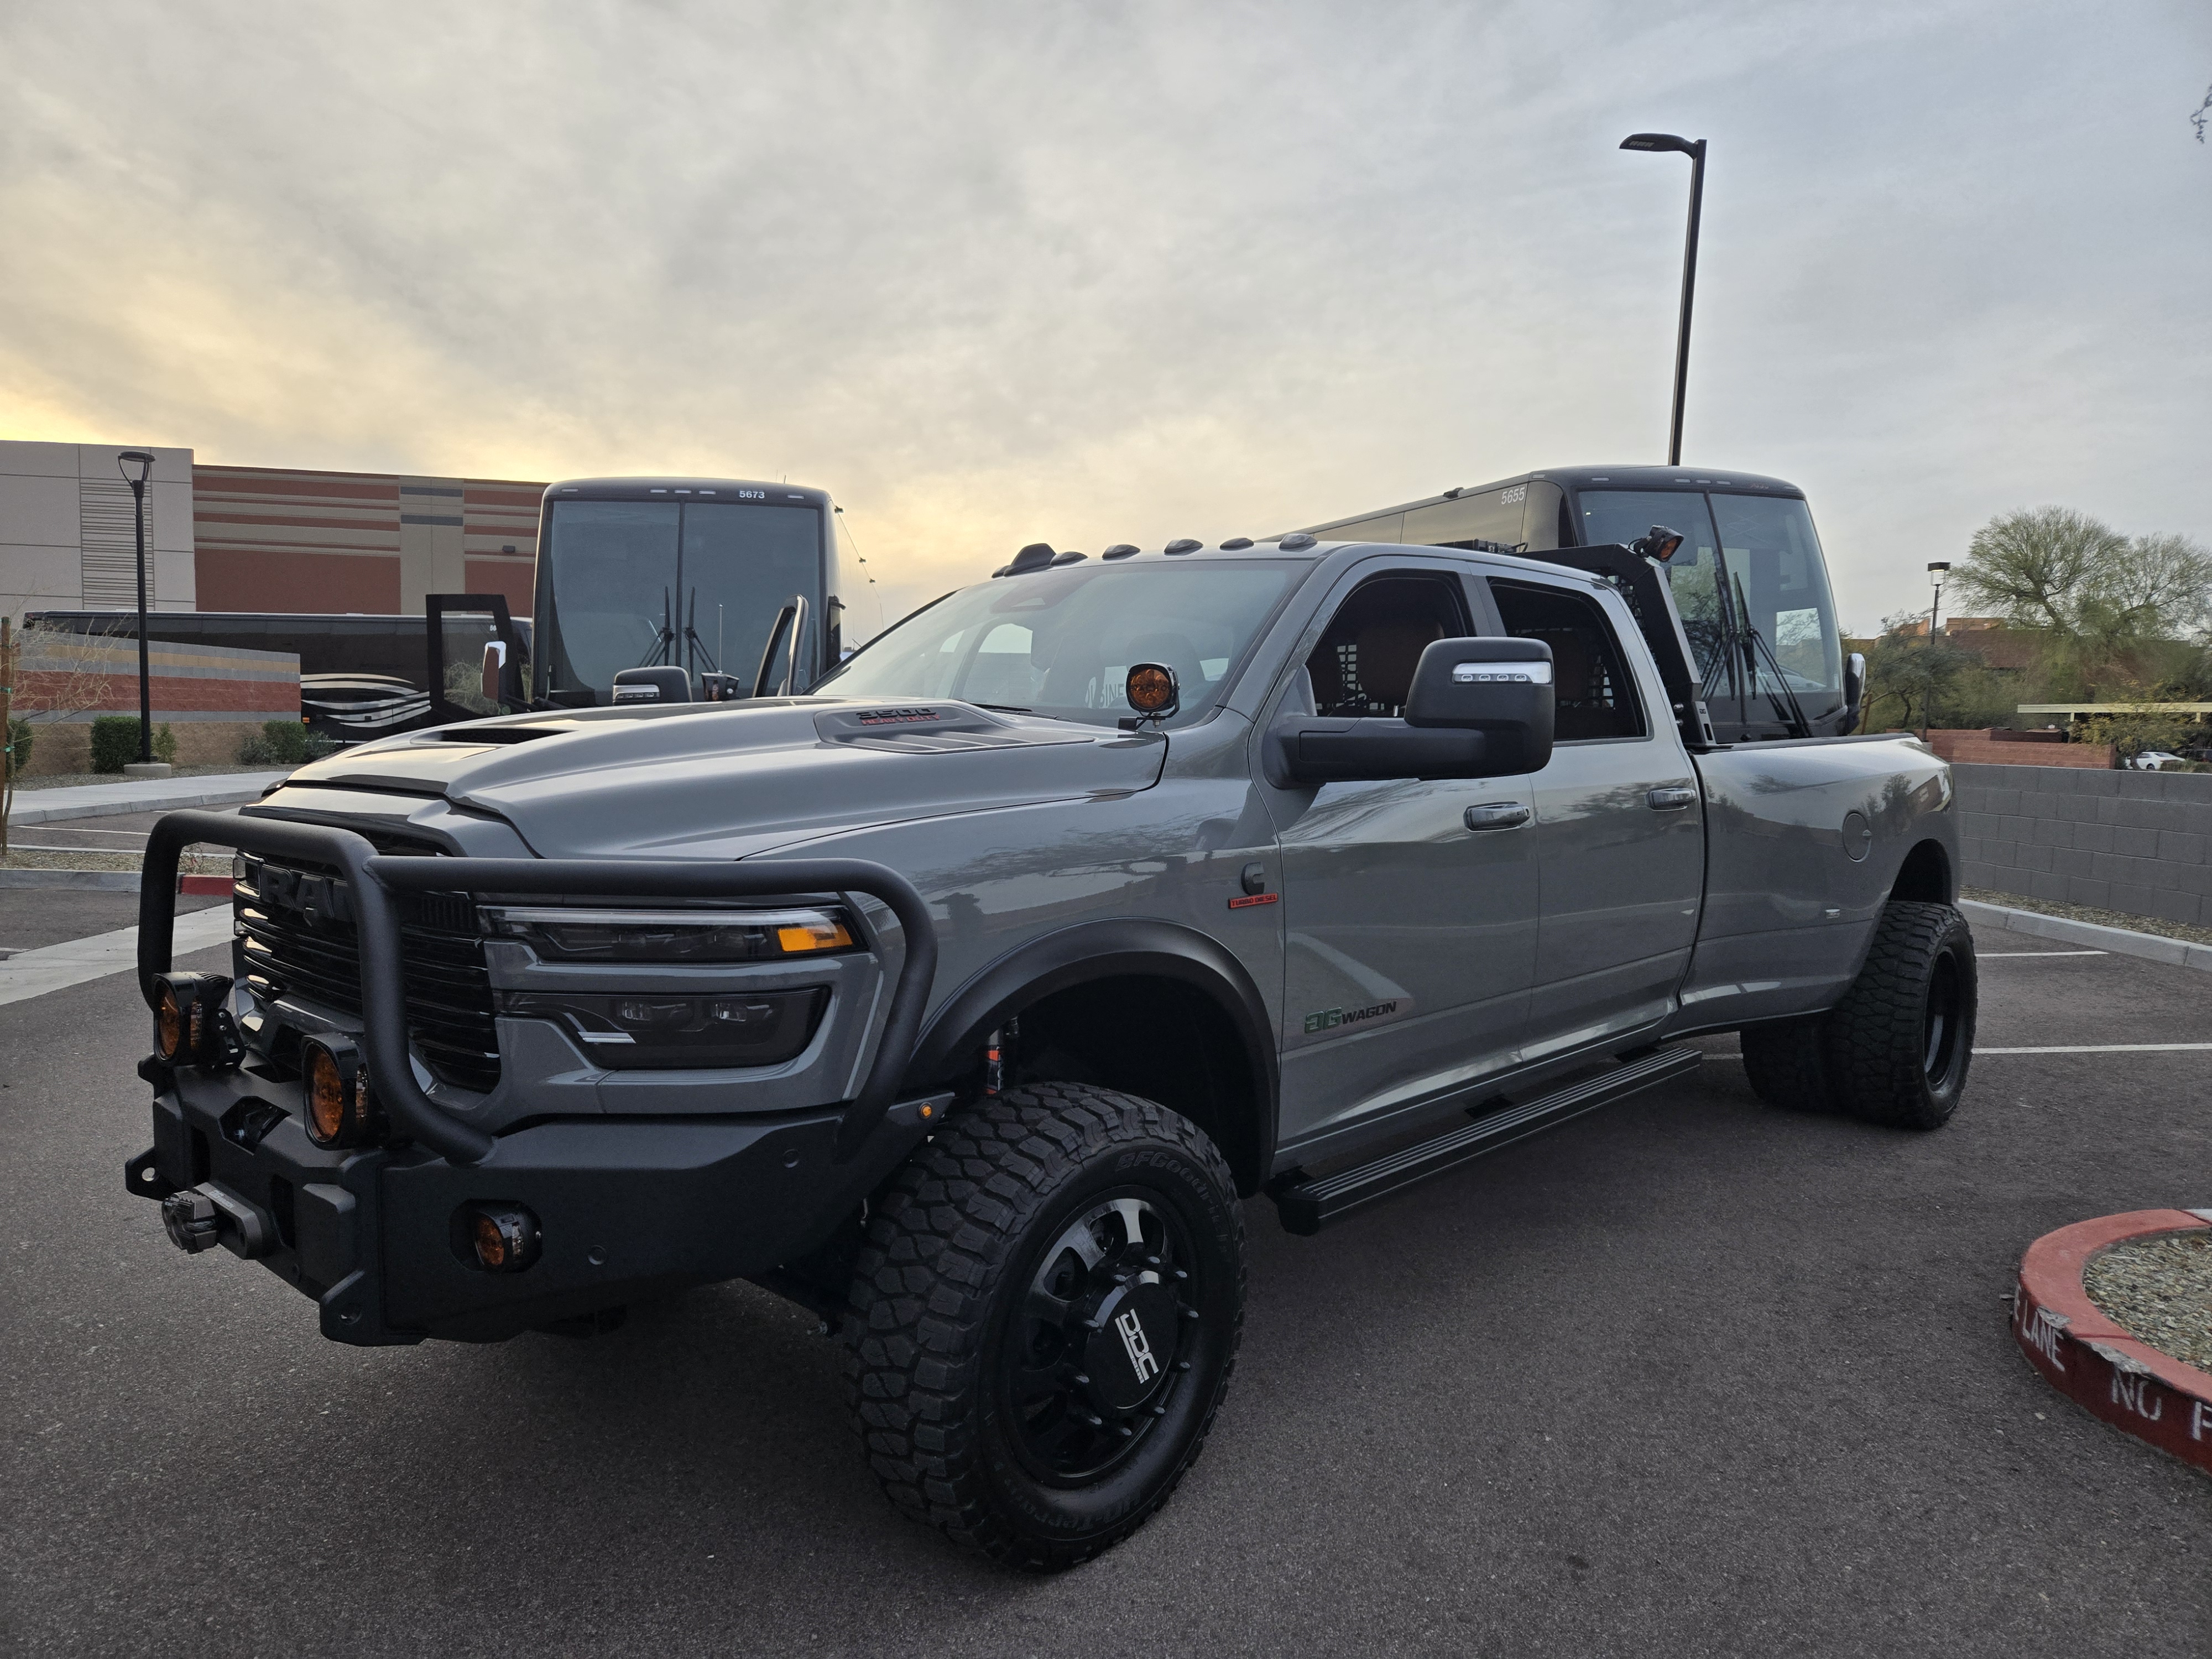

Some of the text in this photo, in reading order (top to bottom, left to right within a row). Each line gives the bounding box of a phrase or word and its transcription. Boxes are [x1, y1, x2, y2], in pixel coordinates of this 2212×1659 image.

[739, 491, 765, 499] 5673
[1501, 487, 1525, 505] 5655
[855, 708, 937, 720] 3500
[860, 714, 941, 726] HEAVY DUTY
[1232, 894, 1277, 906] TURBO DIESEL
[1342, 1001, 1397, 1025] WAGON
[2022, 1298, 2065, 1372] LANE
[2111, 1365, 2162, 1421] NO
